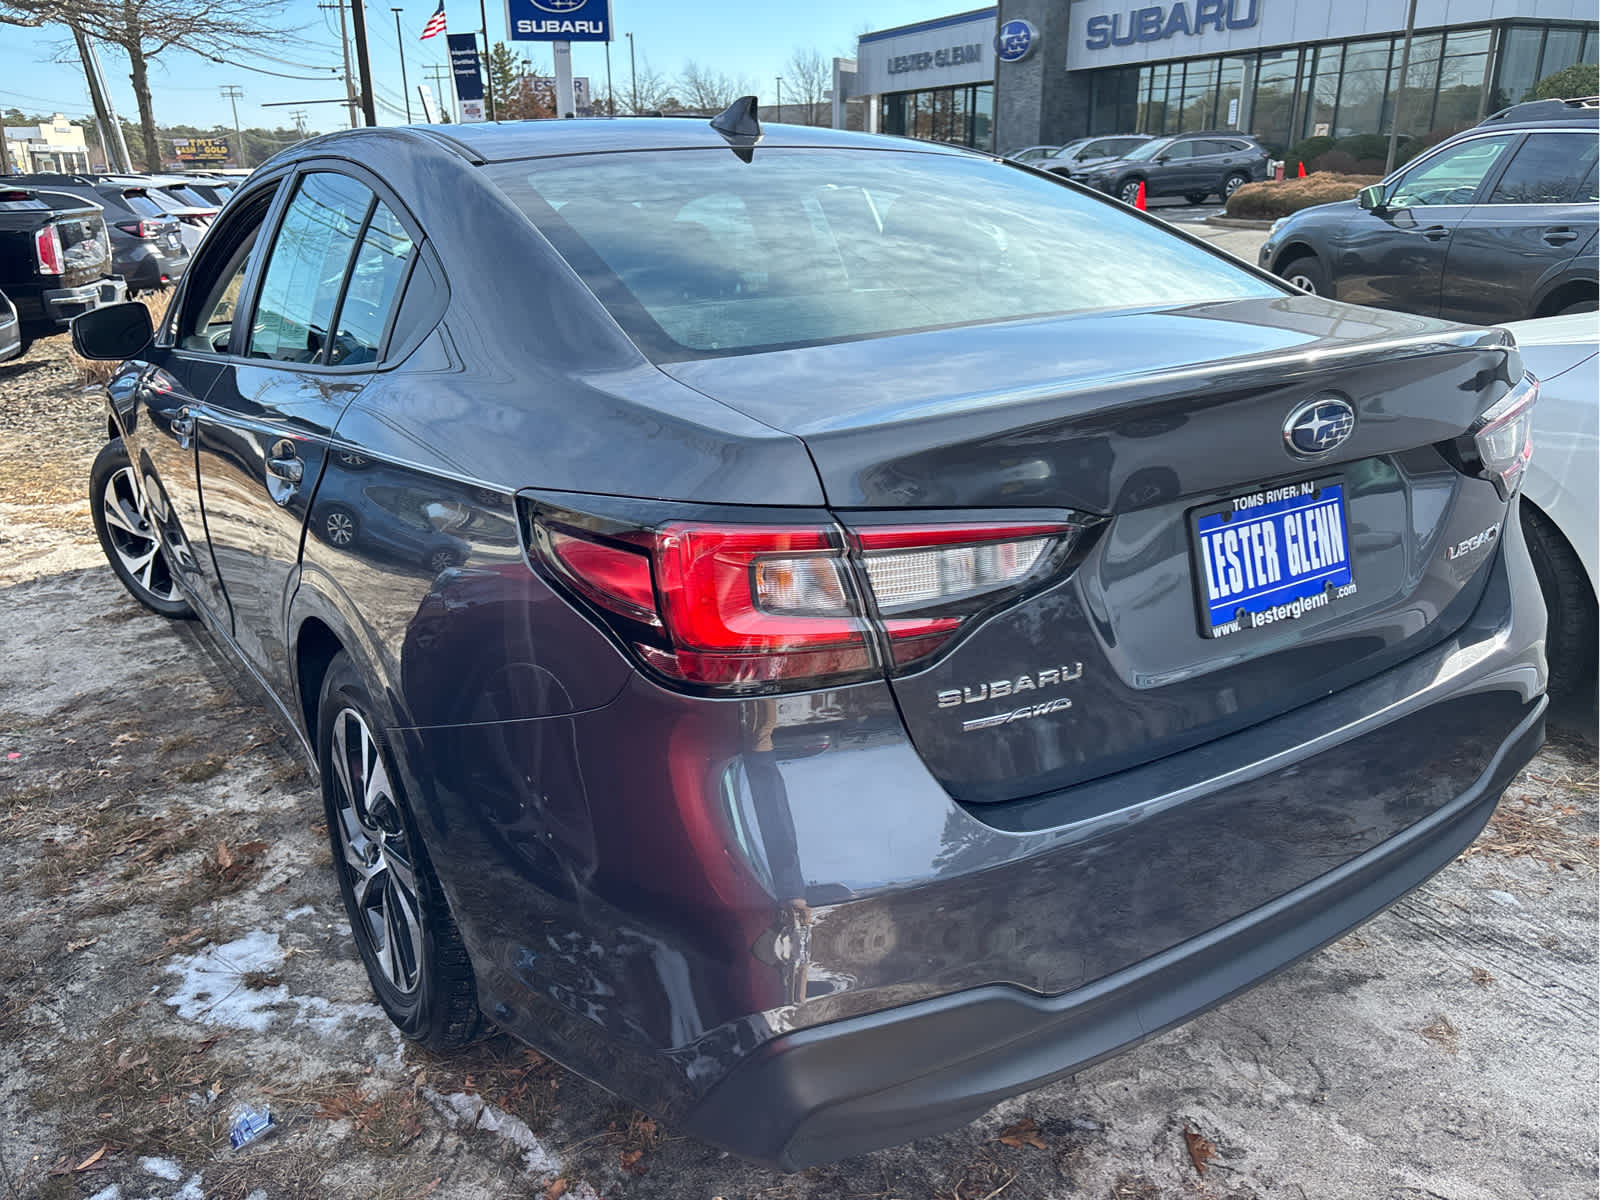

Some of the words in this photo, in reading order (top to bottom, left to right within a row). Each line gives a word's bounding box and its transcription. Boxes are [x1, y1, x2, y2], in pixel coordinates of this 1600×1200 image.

[517, 19, 603, 33] SUBARU
[1086, 0, 1257, 50] SUBARU
[887, 51, 932, 75] LESTER
[935, 44, 983, 68] GLENN
[1232, 493, 1264, 511] TOMS
[1266, 486, 1300, 503] RIVER,
[1301, 481, 1314, 495] NJ
[1201, 520, 1281, 601] LESTER
[1283, 503, 1345, 577] GLENN
[1212, 621, 1242, 638] www.
[1251, 593, 1329, 628] lesterglenn
[937, 662, 1083, 708] SUBARU
[1006, 698, 1073, 723] AWD
